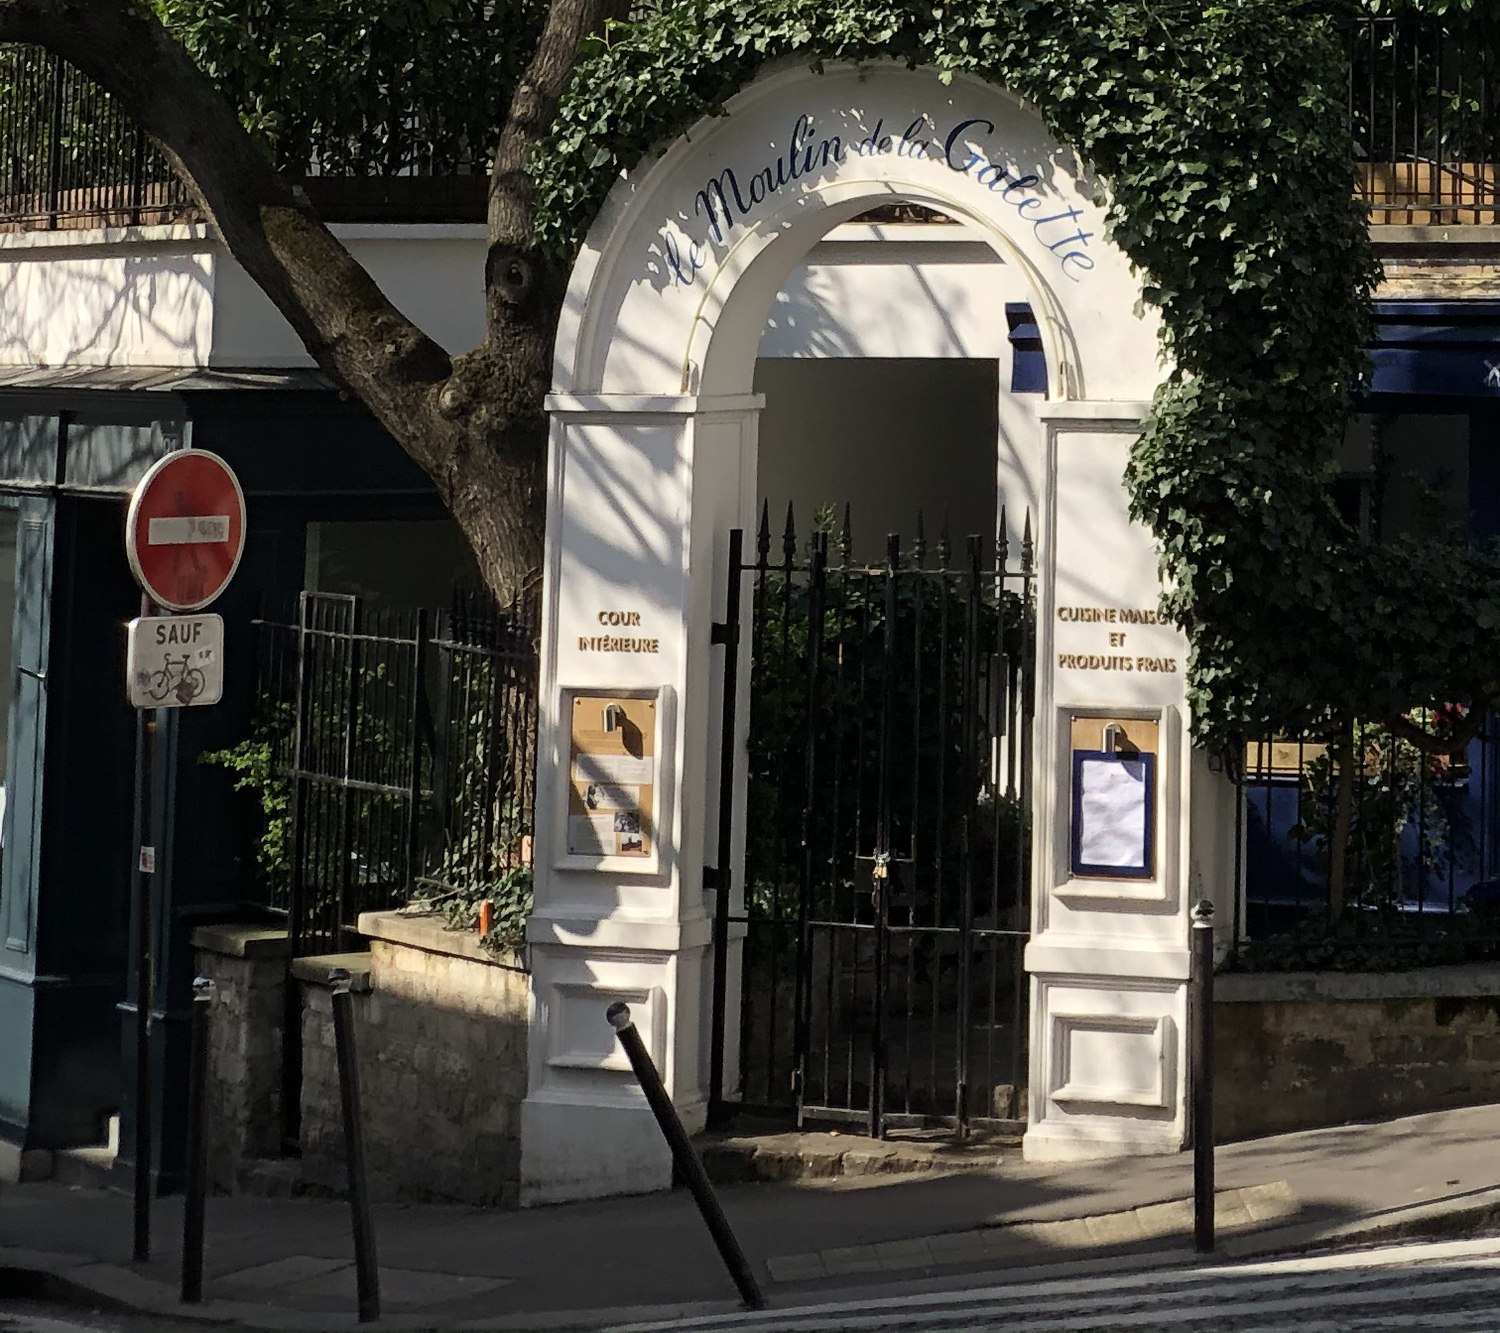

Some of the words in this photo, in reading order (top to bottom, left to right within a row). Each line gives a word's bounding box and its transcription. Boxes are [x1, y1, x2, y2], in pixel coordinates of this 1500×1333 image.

[694, 113, 846, 243] Moulin
[857, 118, 892, 157] de
[897, 116, 932, 160] la
[944, 119, 1096, 284] Galette
[597, 611, 641, 627] COUR
[1057, 606, 1117, 624] CUISINE
[1119, 608, 1173, 626] MAISO
[156, 622, 203, 646] SAUF
[577, 634, 660, 654] INTÉRIEURE
[1108, 631, 1128, 648] ET
[1058, 653, 1134, 672] PRODUITS
[1136, 656, 1178, 673] FRAIS
